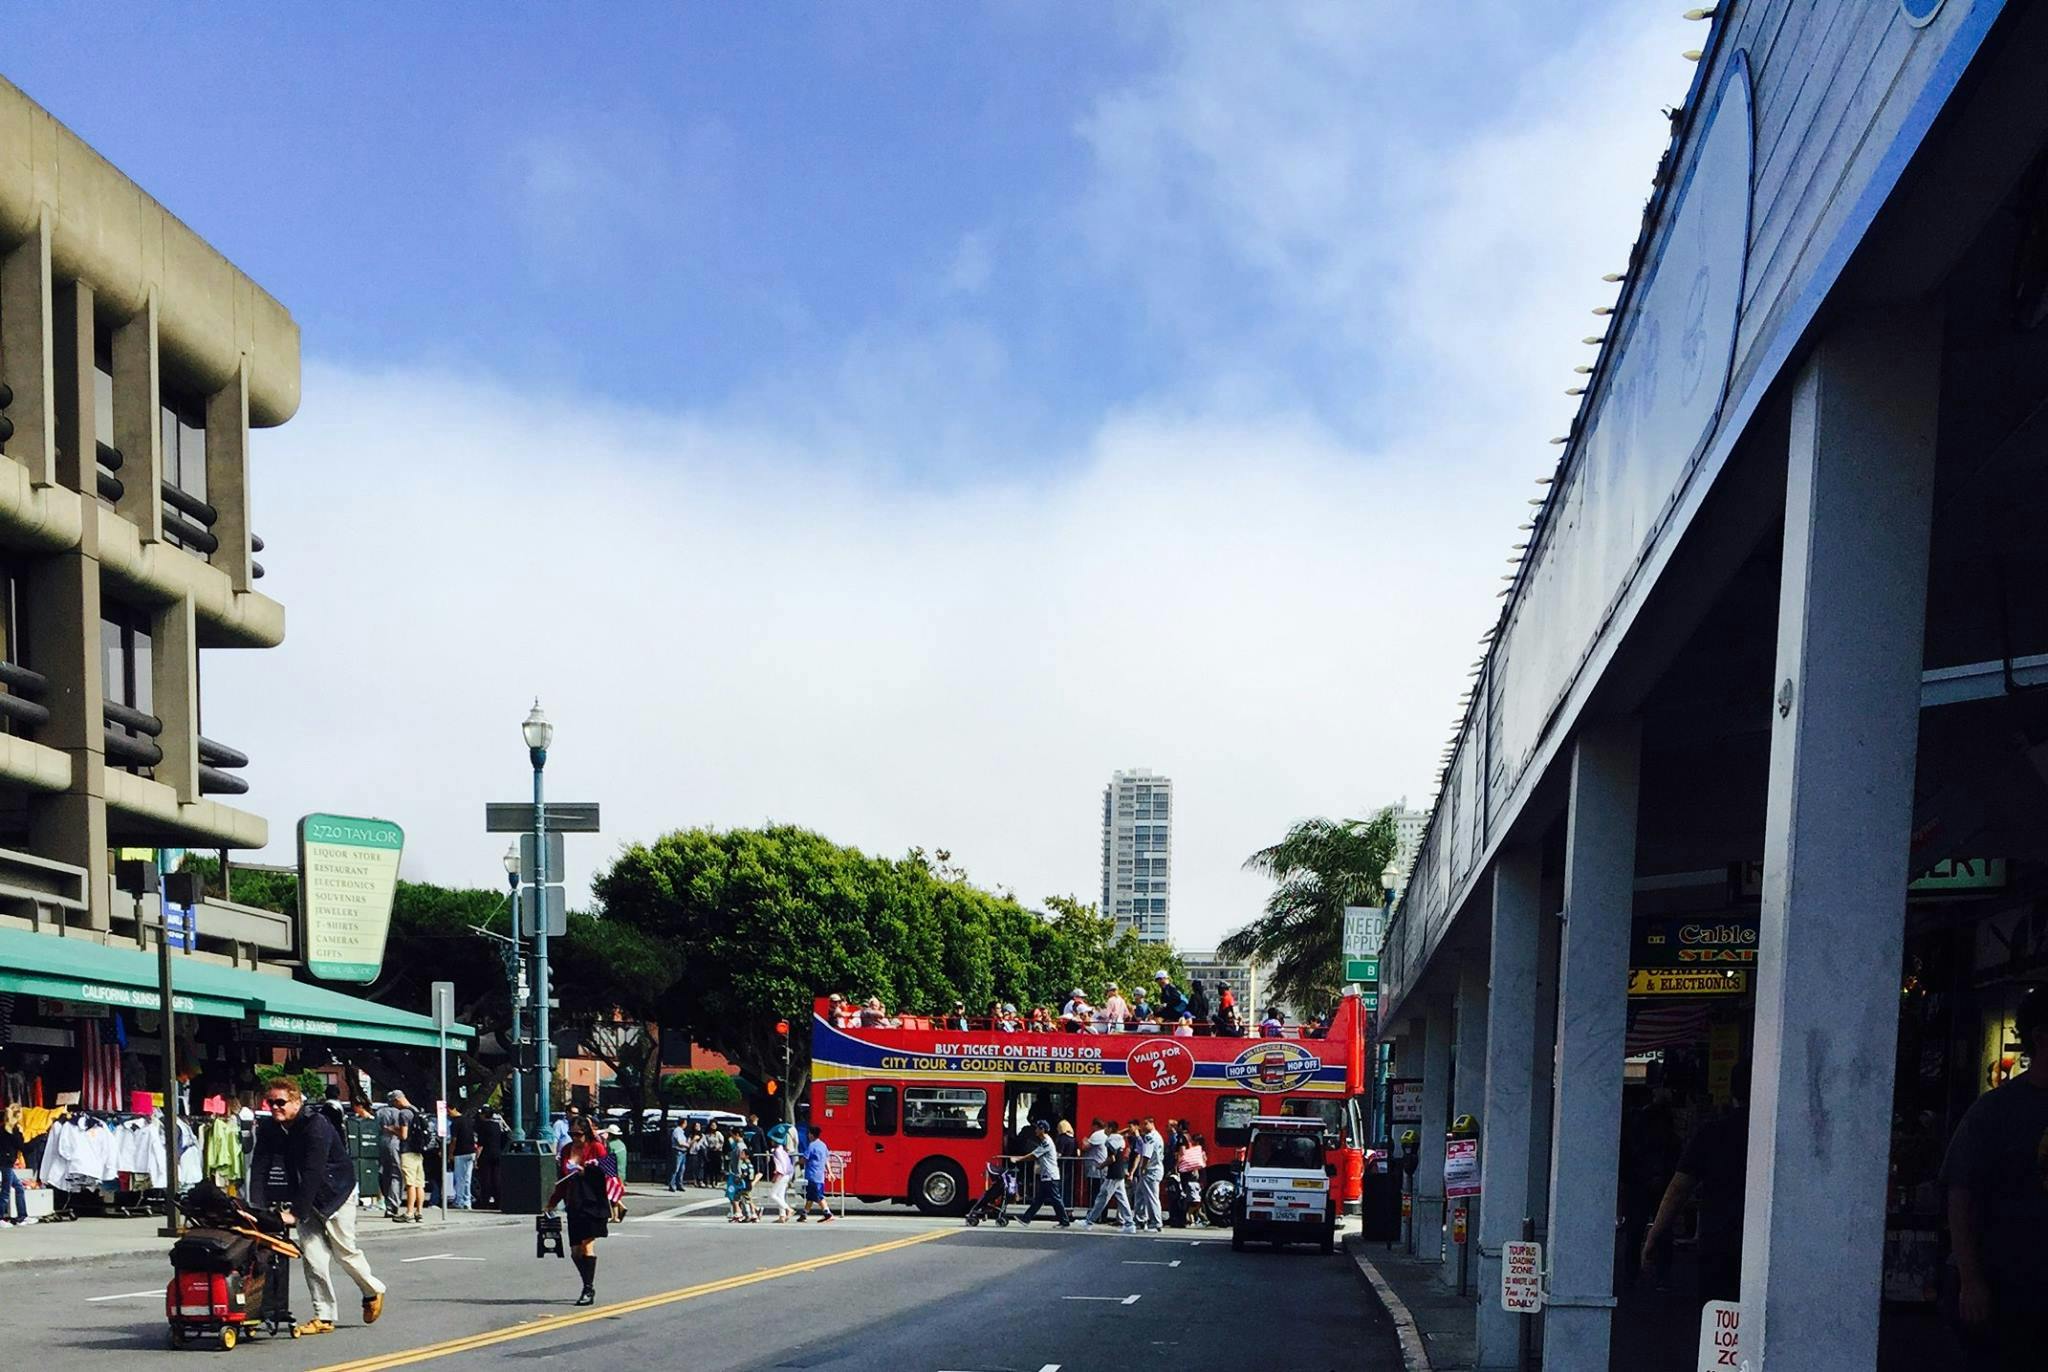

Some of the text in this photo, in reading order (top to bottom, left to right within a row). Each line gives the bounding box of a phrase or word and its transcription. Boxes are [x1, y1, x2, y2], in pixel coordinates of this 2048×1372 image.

[312, 824, 398, 844] 2720 TAYLOR
[313, 848, 381, 861] LIQUOR STORE
[314, 864, 369, 875] RESTAURANT
[314, 878, 376, 890] ELECTRONICS
[315, 891, 367, 904] SOUVENIRS
[315, 906, 358, 917] JEWELERY
[1345, 917, 1382, 935] NEED
[316, 934, 359, 945] CAMERAS
[1678, 924, 1757, 944] Cable
[1345, 935, 1381, 950] APPLY
[316, 947, 343, 958] GIFTS
[1647, 978, 1655, 990] &
[1661, 976, 1740, 991] ELECTRONICS
[82, 984, 130, 1003] CALIFORNIA
[172, 995, 194, 1010] GIFTS
[269, 1016, 289, 1029] CABLE
[291, 1019, 304, 1031] CAR
[935, 1043, 1101, 1058] BUY TICKET ON THE BUS FOR
[1133, 1047, 1181, 1063] VALID FOR
[882, 1057, 907, 1069] CITY
[913, 1058, 947, 1070] TOUR
[960, 1060, 1014, 1072] GOLDEN
[1018, 1061, 1050, 1073] GATE
[1152, 1059, 1167, 1077] 2
[1229, 1065, 1257, 1076] HOP ON
[1287, 1060, 1317, 1071] HOP OFF
[1150, 1075, 1178, 1089] DAYS
[1509, 1245, 1536, 1256] TOUR BUS
[1509, 1256, 1536, 1265] LOADING
[1511, 1265, 1534, 1274] ZONE
[1508, 1298, 1534, 1308] DAILY
[1716, 1309, 1739, 1329] TOU
